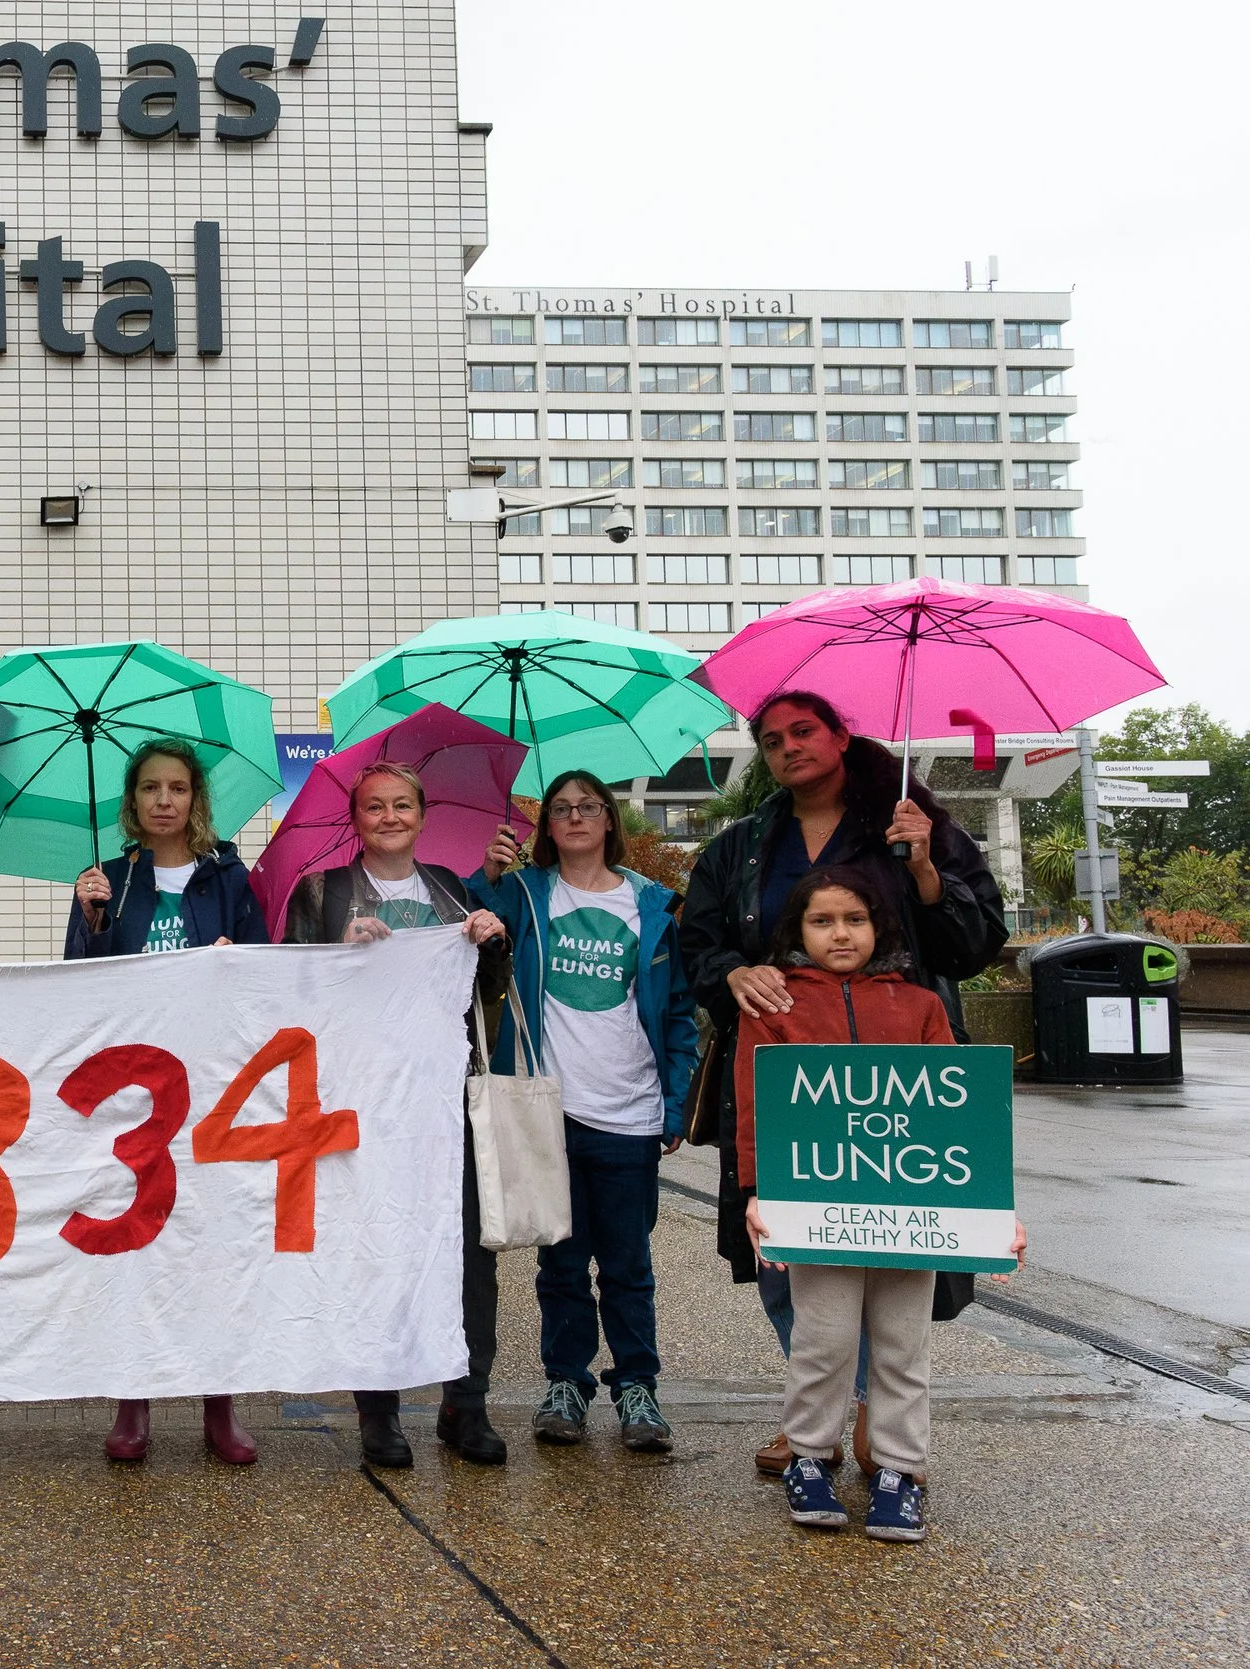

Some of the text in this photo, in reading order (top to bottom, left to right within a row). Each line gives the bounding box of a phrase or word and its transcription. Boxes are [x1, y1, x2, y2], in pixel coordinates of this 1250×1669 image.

[466, 290, 499, 312] St.
[660, 293, 796, 322] Hospital
[1008, 737, 1025, 745] Bridge
[1026, 737, 1054, 745] Consulting
[1117, 795, 1150, 803] Management
[161, 929, 180, 938] FOR
[557, 934, 625, 956] MUMS
[579, 952, 600, 961] FOR
[551, 957, 624, 982] LUNGS
[790, 1063, 968, 1108] MUMS
[847, 1112, 911, 1138] FOR
[791, 1141, 972, 1186] LUNGS
[824, 1206, 940, 1228] CLEAN AIR
[808, 1226, 959, 1250] HEALTHY KIDS
